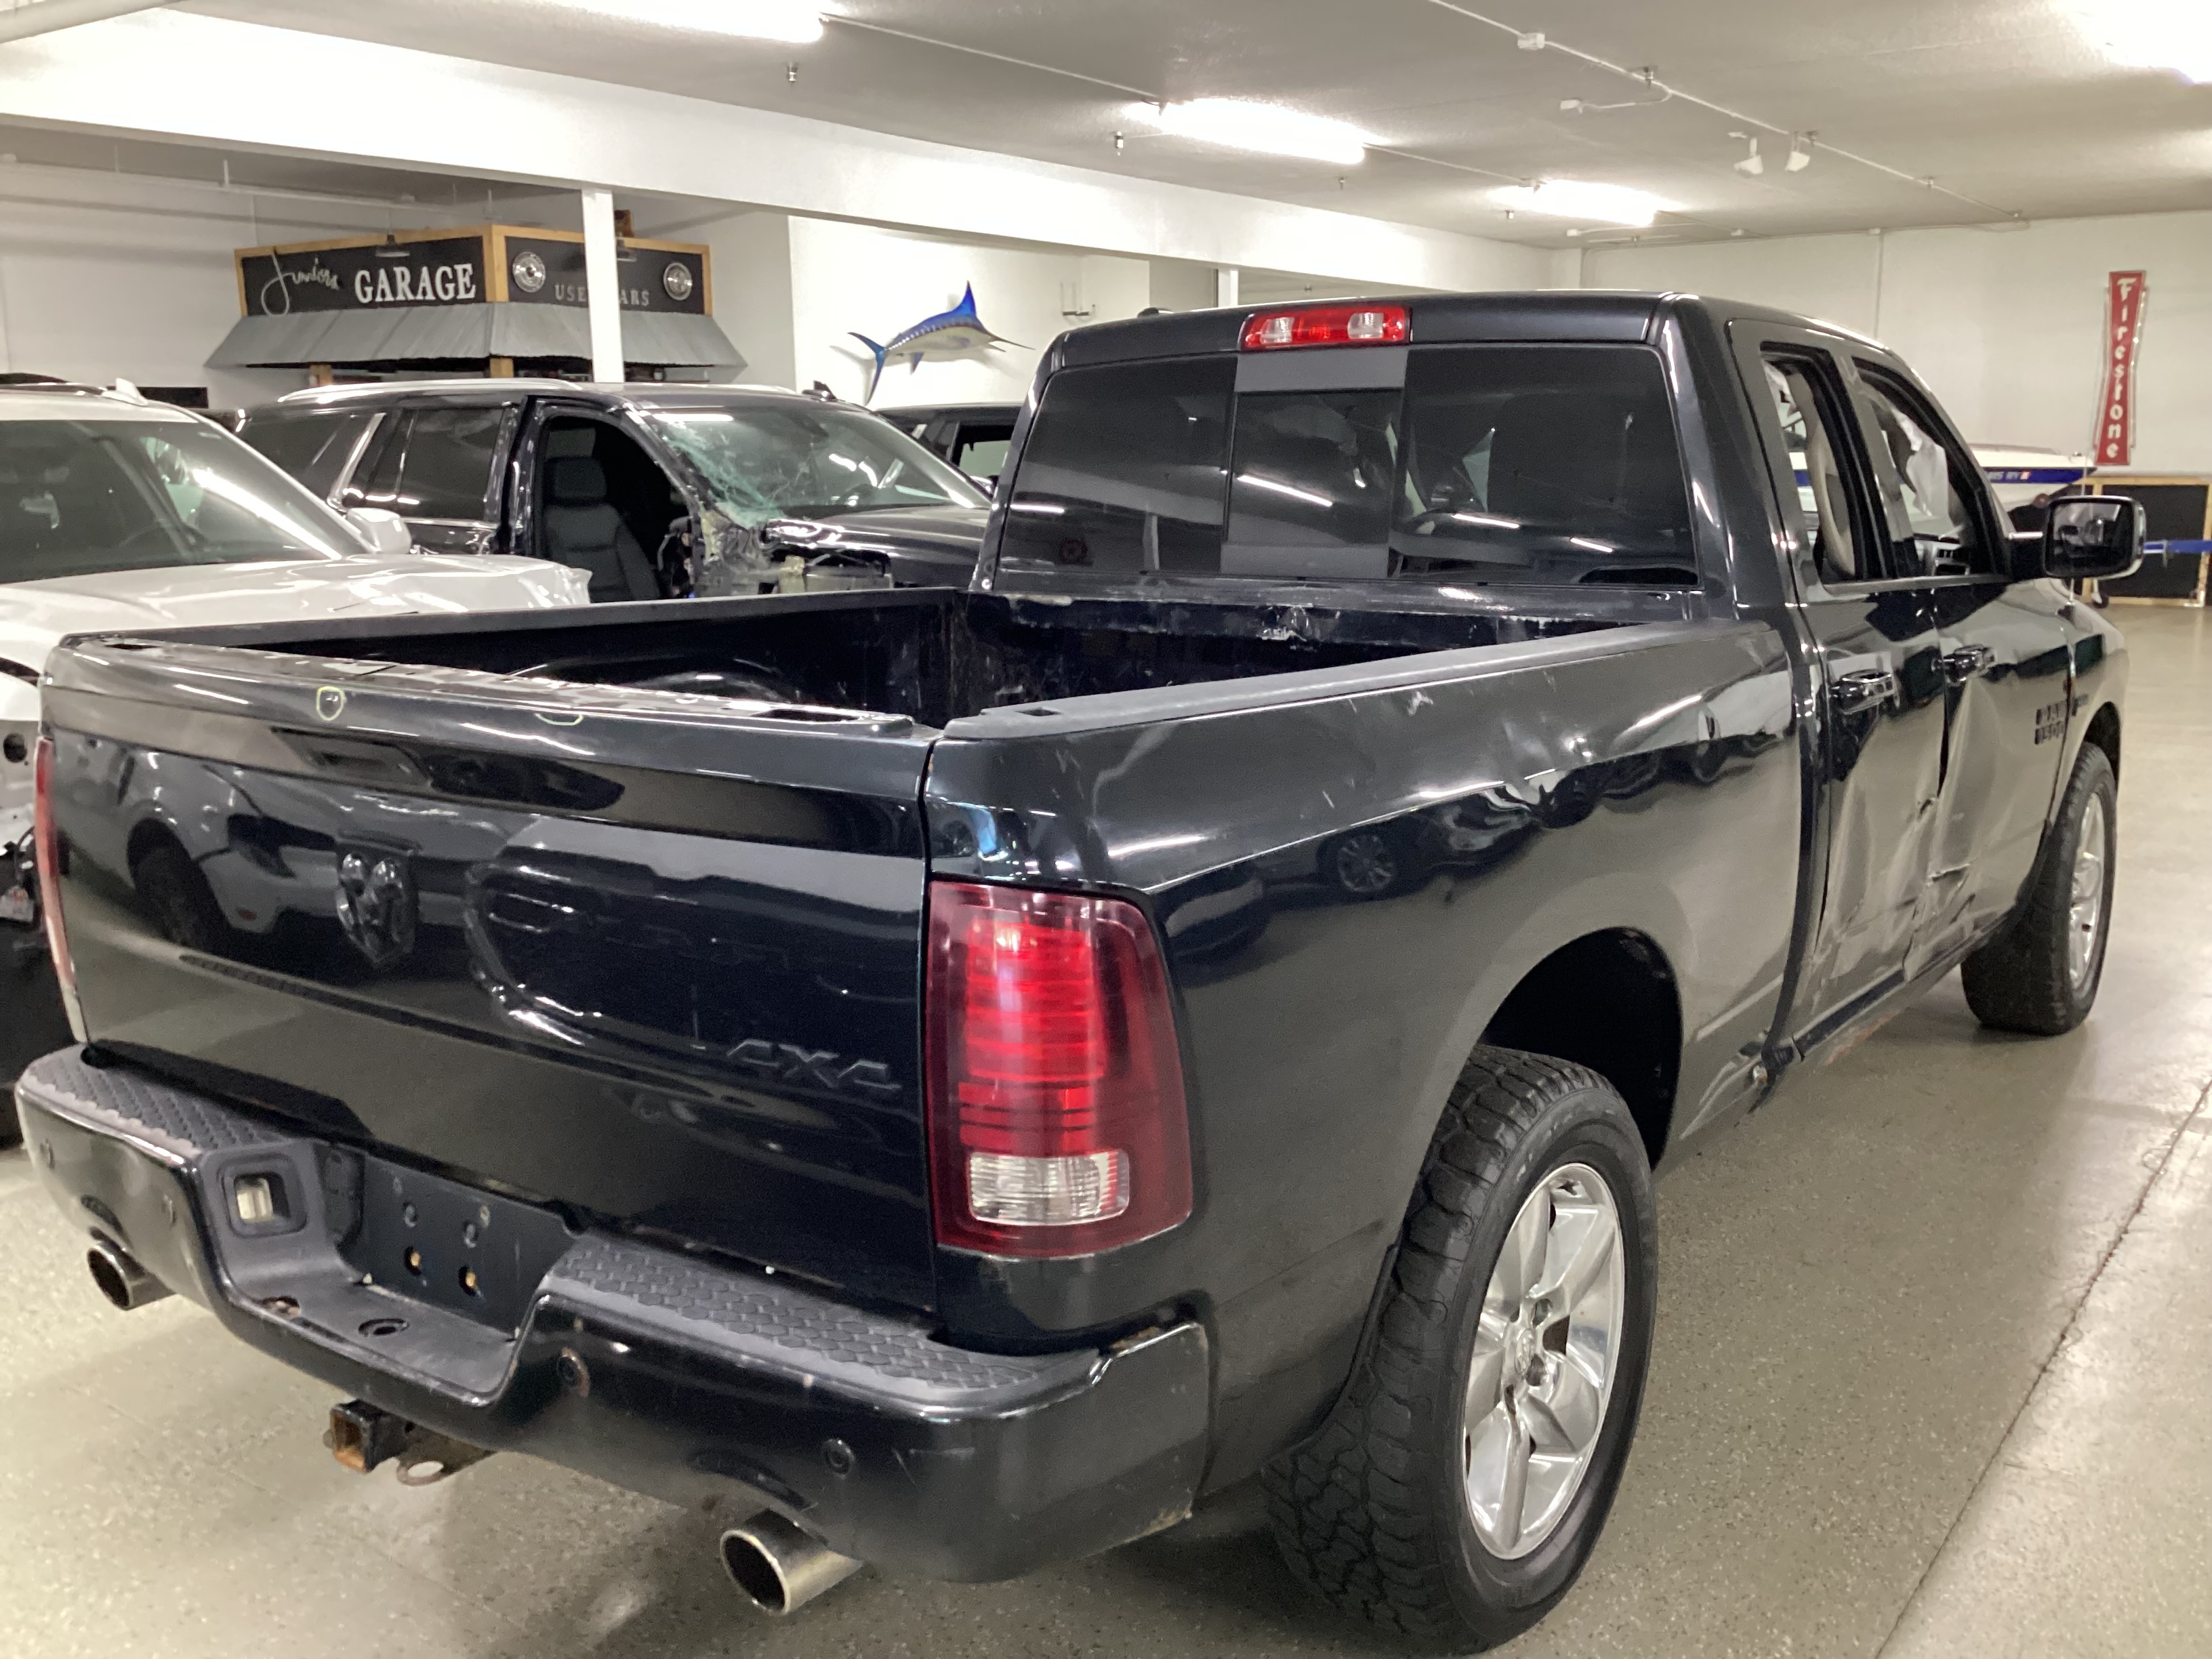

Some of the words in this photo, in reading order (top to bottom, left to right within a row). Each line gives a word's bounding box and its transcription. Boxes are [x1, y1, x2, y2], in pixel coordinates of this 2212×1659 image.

[354, 263, 476, 303] GARAGE
[554, 283, 587, 302] USE
[619, 289, 650, 306] ARS
[2106, 276, 2137, 459] Firestone
